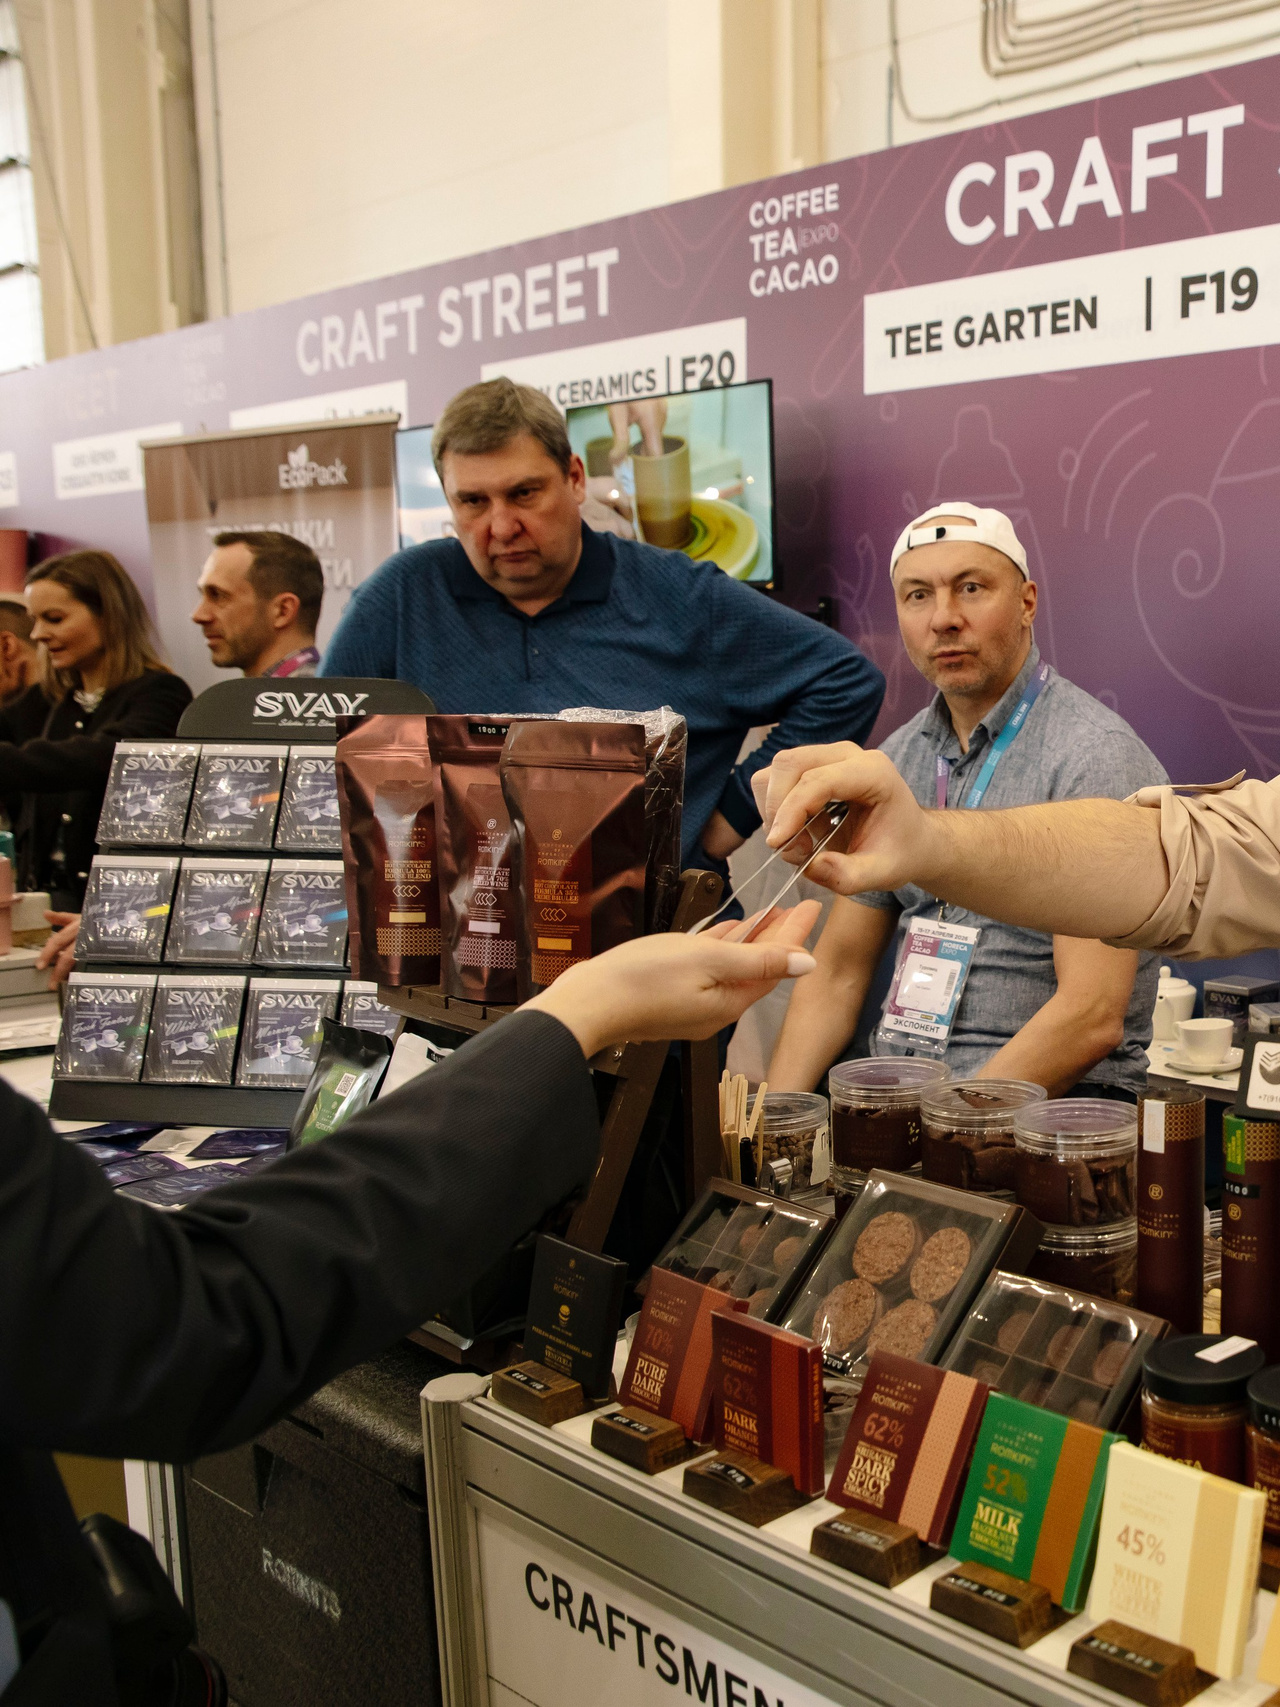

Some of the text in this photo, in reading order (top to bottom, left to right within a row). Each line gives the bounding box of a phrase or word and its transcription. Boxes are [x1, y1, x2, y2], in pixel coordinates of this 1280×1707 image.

[944, 103, 1246, 247] CRAFT
[748, 182, 840, 230] COFFEE
[748, 223, 839, 263] TEA EXPO
[748, 253, 840, 298] CACAO
[295, 293, 426, 377] CRAFT
[436, 246, 620, 349] STREET
[884, 266, 1259, 359] TEE GARTEN F19
[556, 349, 736, 406] CERAMICS F20
[278, 456, 348, 490] EcoPack
[910, 945, 932, 955] CACAO
[911, 940, 923, 948] TEA
[913, 934, 934, 944] COFFEE
[931, 930, 954, 940] АПРЕЛЯ
[954, 934, 968, 942] 2026
[942, 941, 968, 952] HORECA
[940, 947, 958, 956] EXPO
[893, 1017, 941, 1034] ЭКСПОНЕНТ
[632, 1371, 664, 1397] DARK
[635, 1357, 668, 1383] PURE
[630, 1385, 661, 1404] CHOCOLATE
[723, 1406, 758, 1433] DARK
[862, 1411, 906, 1449] 62%
[724, 1422, 759, 1446] ORANGE
[851, 1454, 893, 1482] DARK
[847, 1468, 890, 1497] SPICY
[982, 1462, 1029, 1505] 52%
[975, 1501, 1022, 1537] MILK
[1116, 1523, 1166, 1566] 45%
